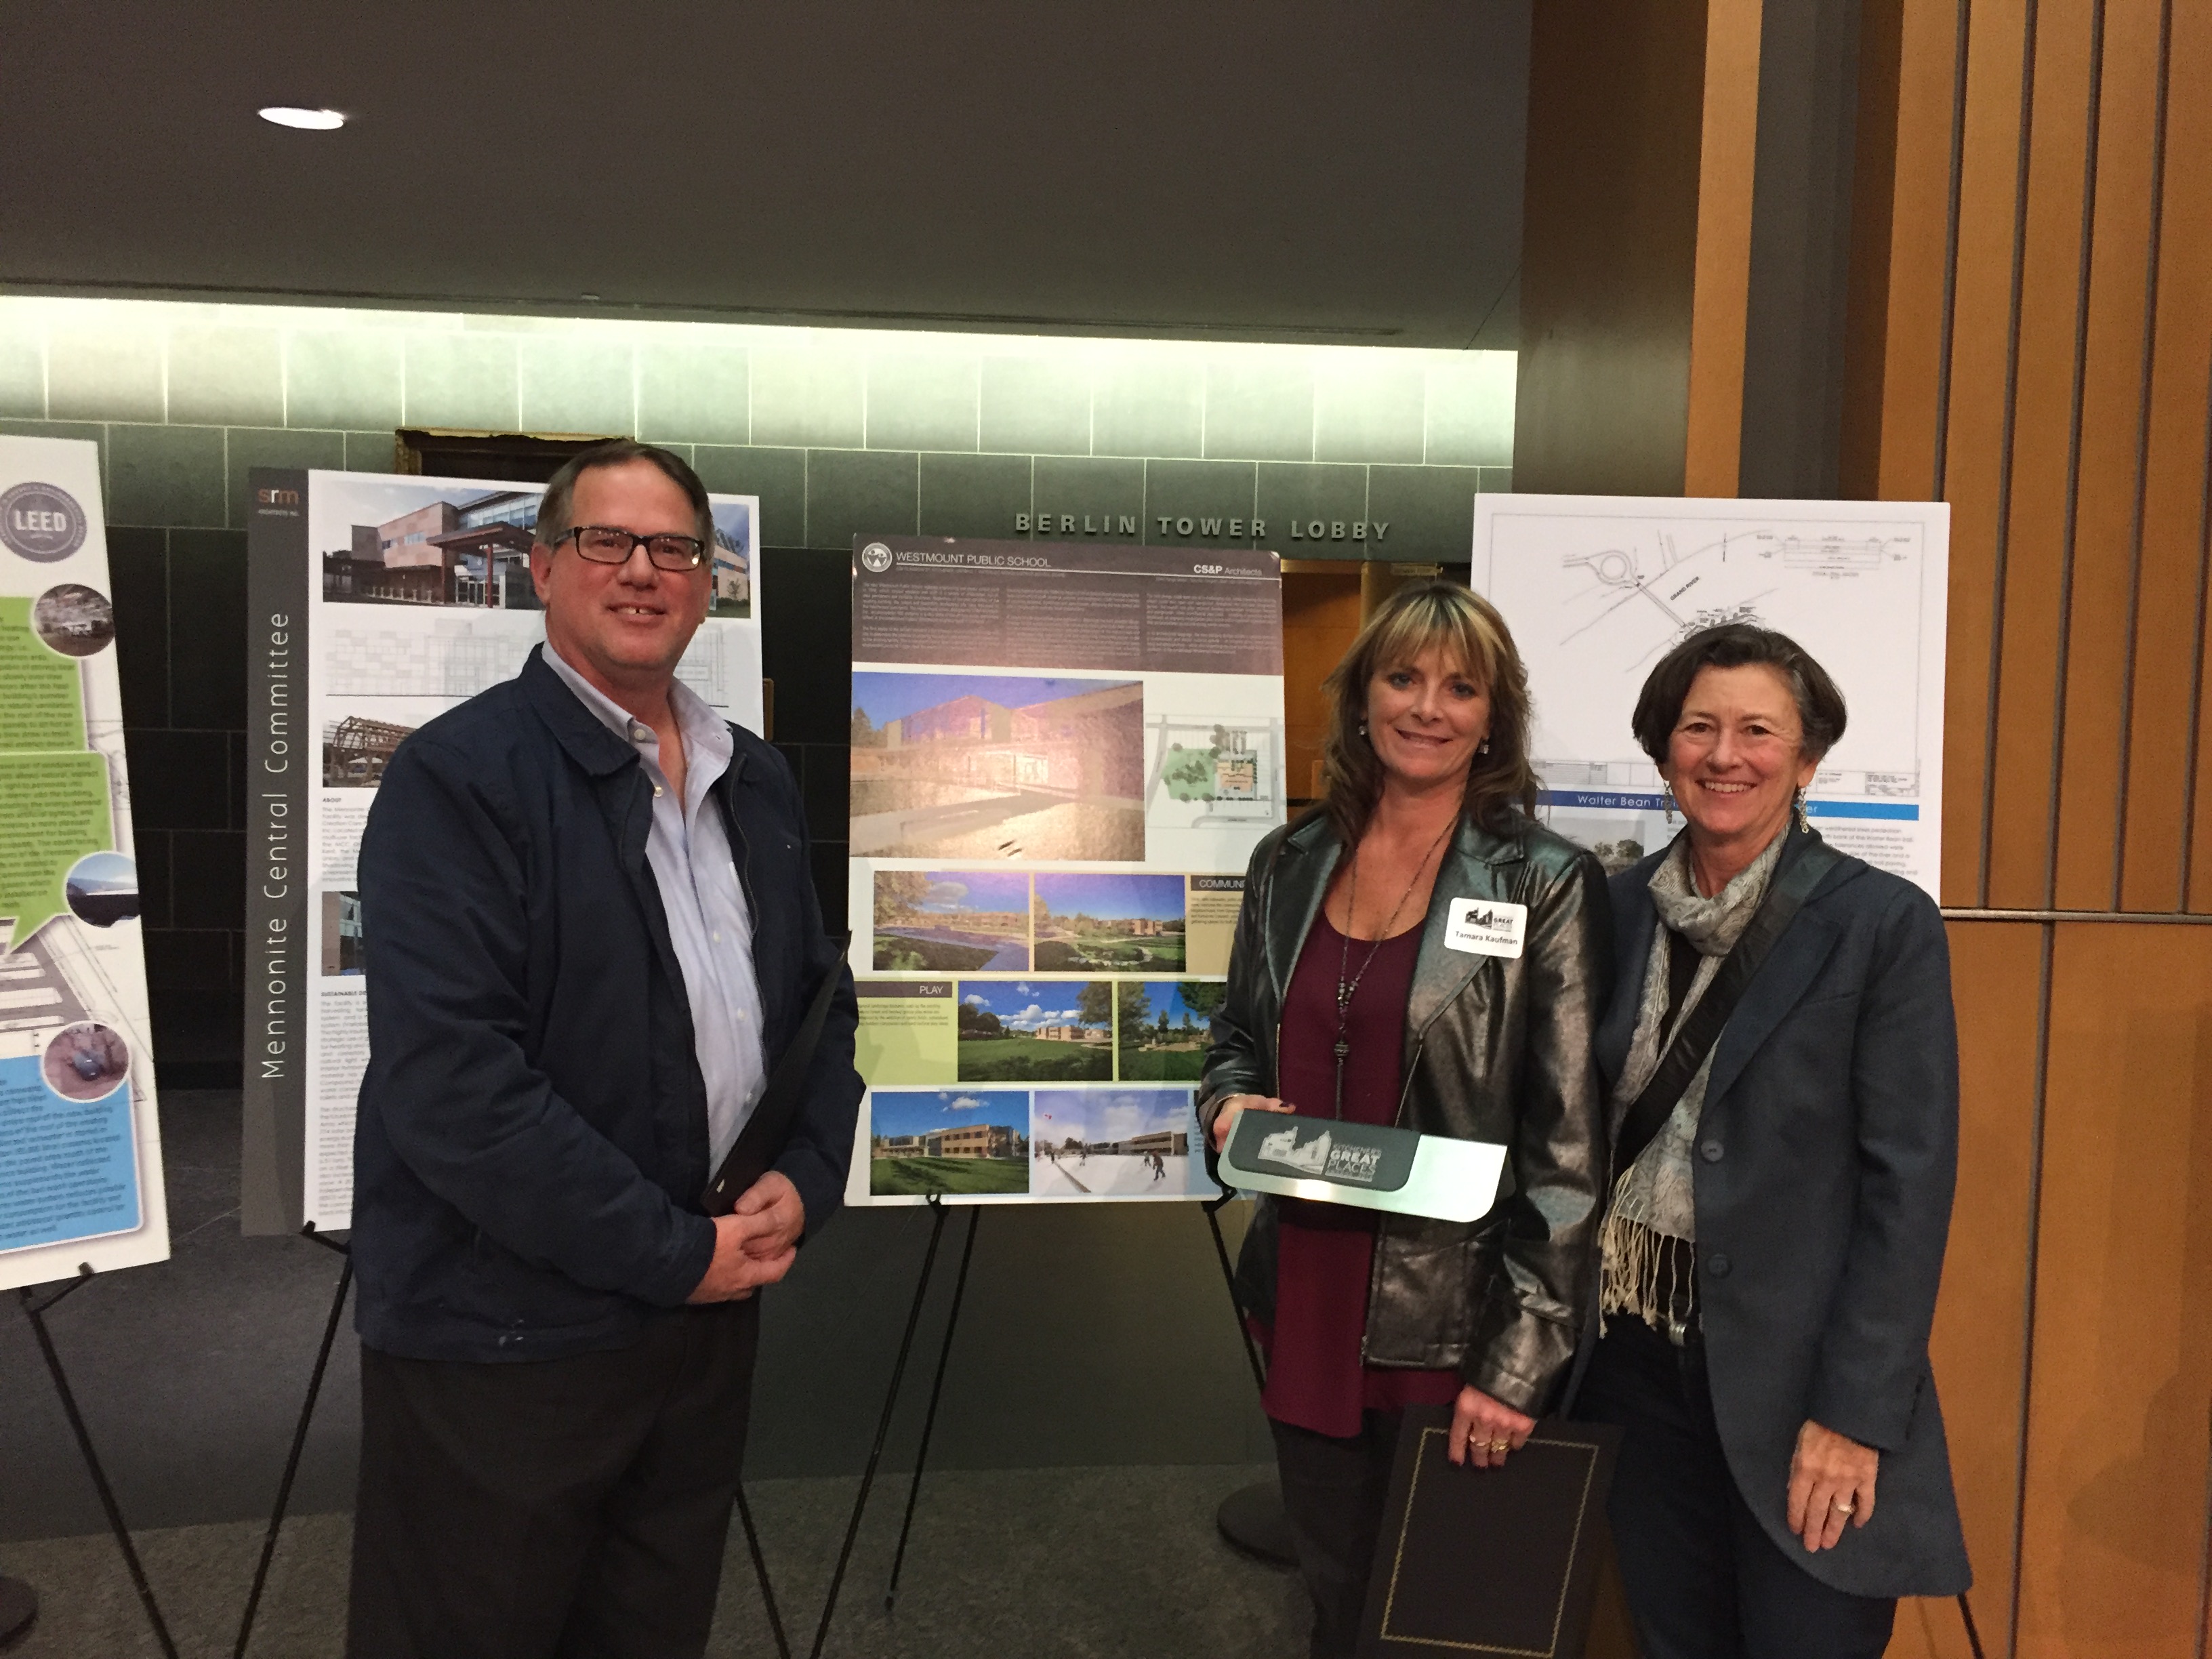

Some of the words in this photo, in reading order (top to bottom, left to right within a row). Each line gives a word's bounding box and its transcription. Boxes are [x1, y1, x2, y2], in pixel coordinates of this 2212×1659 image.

[258, 489, 299, 504] srm
[15, 509, 67, 531] LEED
[1015, 513, 1135, 535] BERLIN
[1157, 517, 1265, 537] TOWER
[1292, 520, 1389, 539] LOBBY
[896, 552, 964, 564] WESTMOUNT
[967, 554, 1005, 565] PUBLIC
[1006, 557, 1051, 567] SCHOOL
[1193, 564, 1223, 574] CS&P
[264, 613, 289, 773] Committee
[1578, 795, 1616, 805] Walter
[1620, 796, 1650, 806] Bean
[1655, 798, 1679, 808] Tri
[262, 794, 288, 899] Central
[1456, 930, 1483, 941] Tamara
[1485, 935, 1518, 945] Kaufman
[261, 918, 287, 1078] Mennonite
[919, 985, 943, 995] PLAY
[1330, 1149, 1381, 1165] GREAT
[1328, 1158, 1377, 1174] PLACES
